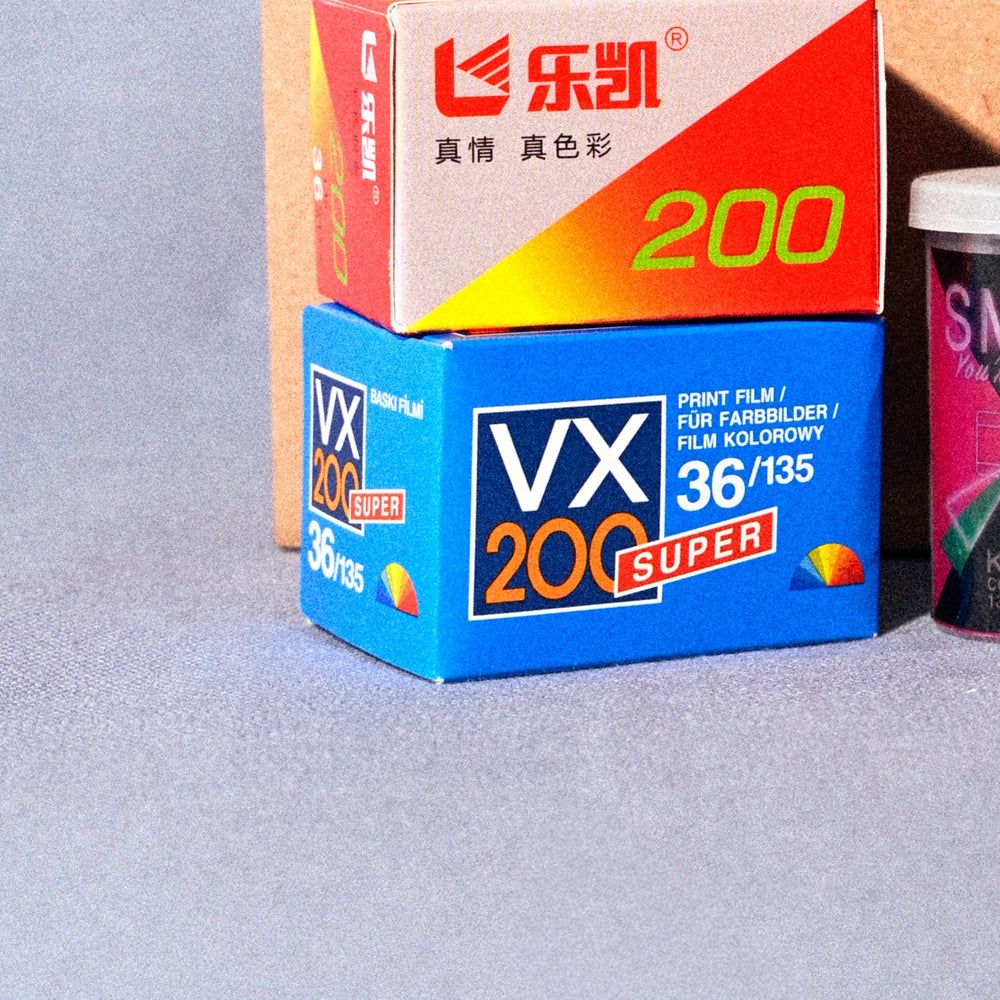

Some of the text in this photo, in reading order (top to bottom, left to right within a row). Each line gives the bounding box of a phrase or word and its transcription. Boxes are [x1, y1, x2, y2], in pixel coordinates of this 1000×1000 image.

[527, 40, 662, 113] 乐凯
[435, 132, 613, 165] 真情 真色彩
[631, 185, 846, 271] 200
[315, 378, 361, 460] VX
[370, 388, 397, 411] BASKI
[678, 390, 729, 409] PRINT
[735, 387, 775, 405] FILM
[678, 410, 712, 430] FÜR
[719, 404, 828, 427] FARBBILDER
[490, 412, 650, 512] VX
[677, 425, 824, 451] FILM KOLOROWY
[313, 447, 360, 519] 200
[354, 495, 400, 518] SUPER
[676, 453, 815, 512] 36/135
[308, 519, 364, 594] 36/135
[485, 511, 649, 604] 200
[631, 517, 762, 584] SUPER
